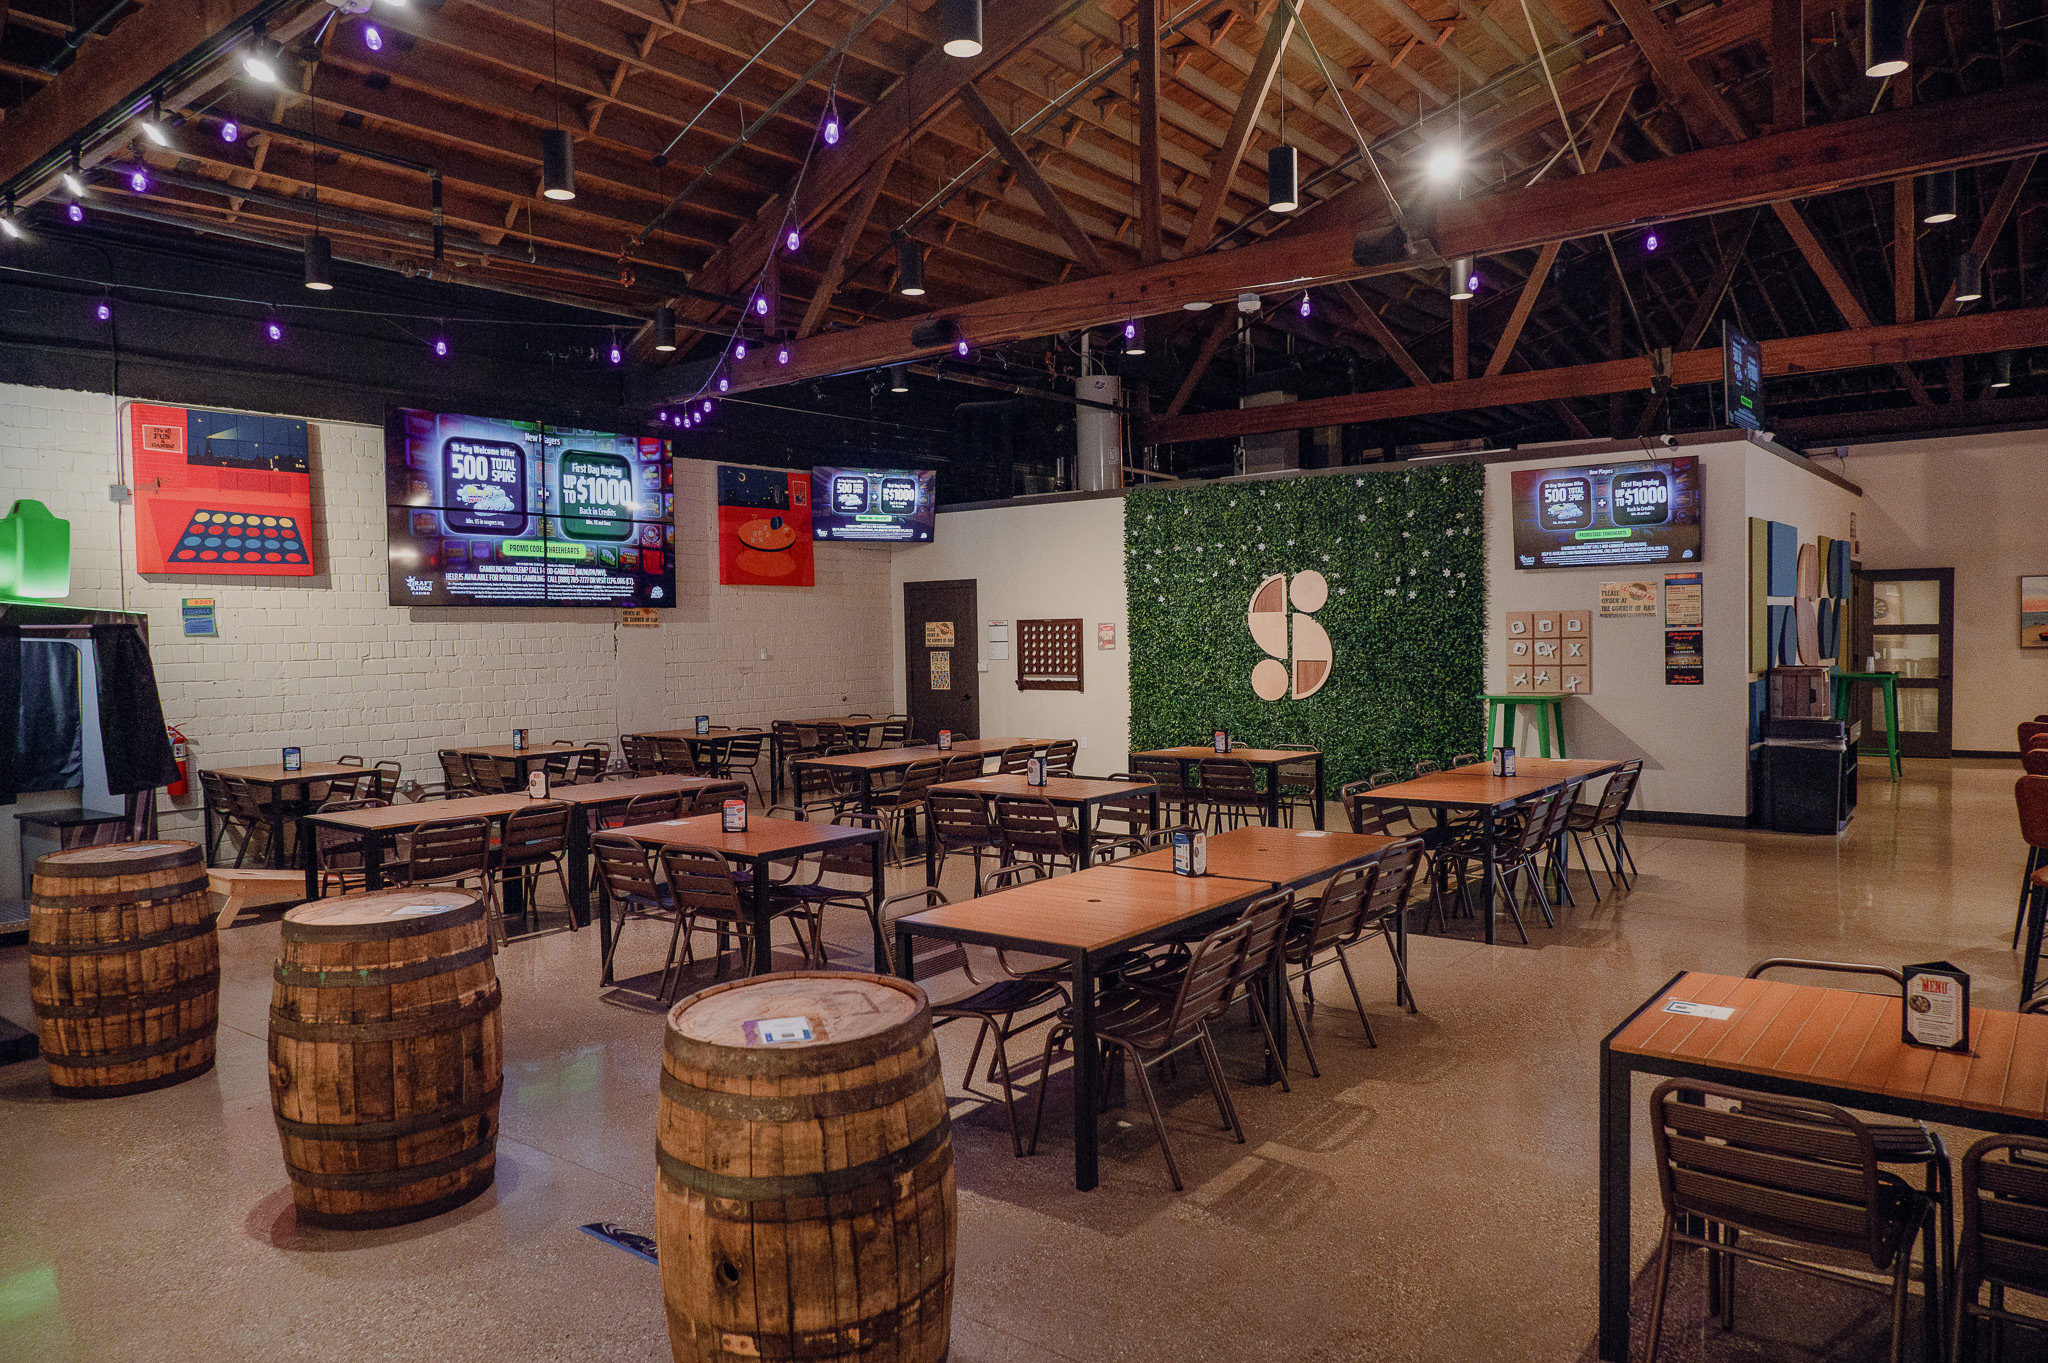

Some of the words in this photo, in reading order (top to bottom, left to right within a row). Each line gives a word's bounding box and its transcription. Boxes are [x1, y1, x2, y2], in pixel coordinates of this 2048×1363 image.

[524, 432, 538, 442] New
[452, 444, 472, 454] 10-Day
[473, 445, 499, 456] Welcome
[500, 448, 516, 457] Offer
[452, 454, 488, 480] 500
[490, 457, 516, 471] TOTAL
[572, 462, 587, 474] First
[588, 464, 600, 476] Day
[601, 466, 622, 478] Replay
[492, 470, 516, 483] SPINS
[563, 474, 576, 488] UP
[563, 490, 576, 504] TO
[576, 476, 632, 506] $1000
[1545, 488, 1566, 503] 500
[1615, 489, 1624, 498] UP
[1625, 486, 1666, 505] $1000
[1615, 498, 1624, 506] TO
[599, 508, 616, 516] Credits
[510, 544, 528, 552] PROMO
[1920, 979, 1948, 994] MENU
